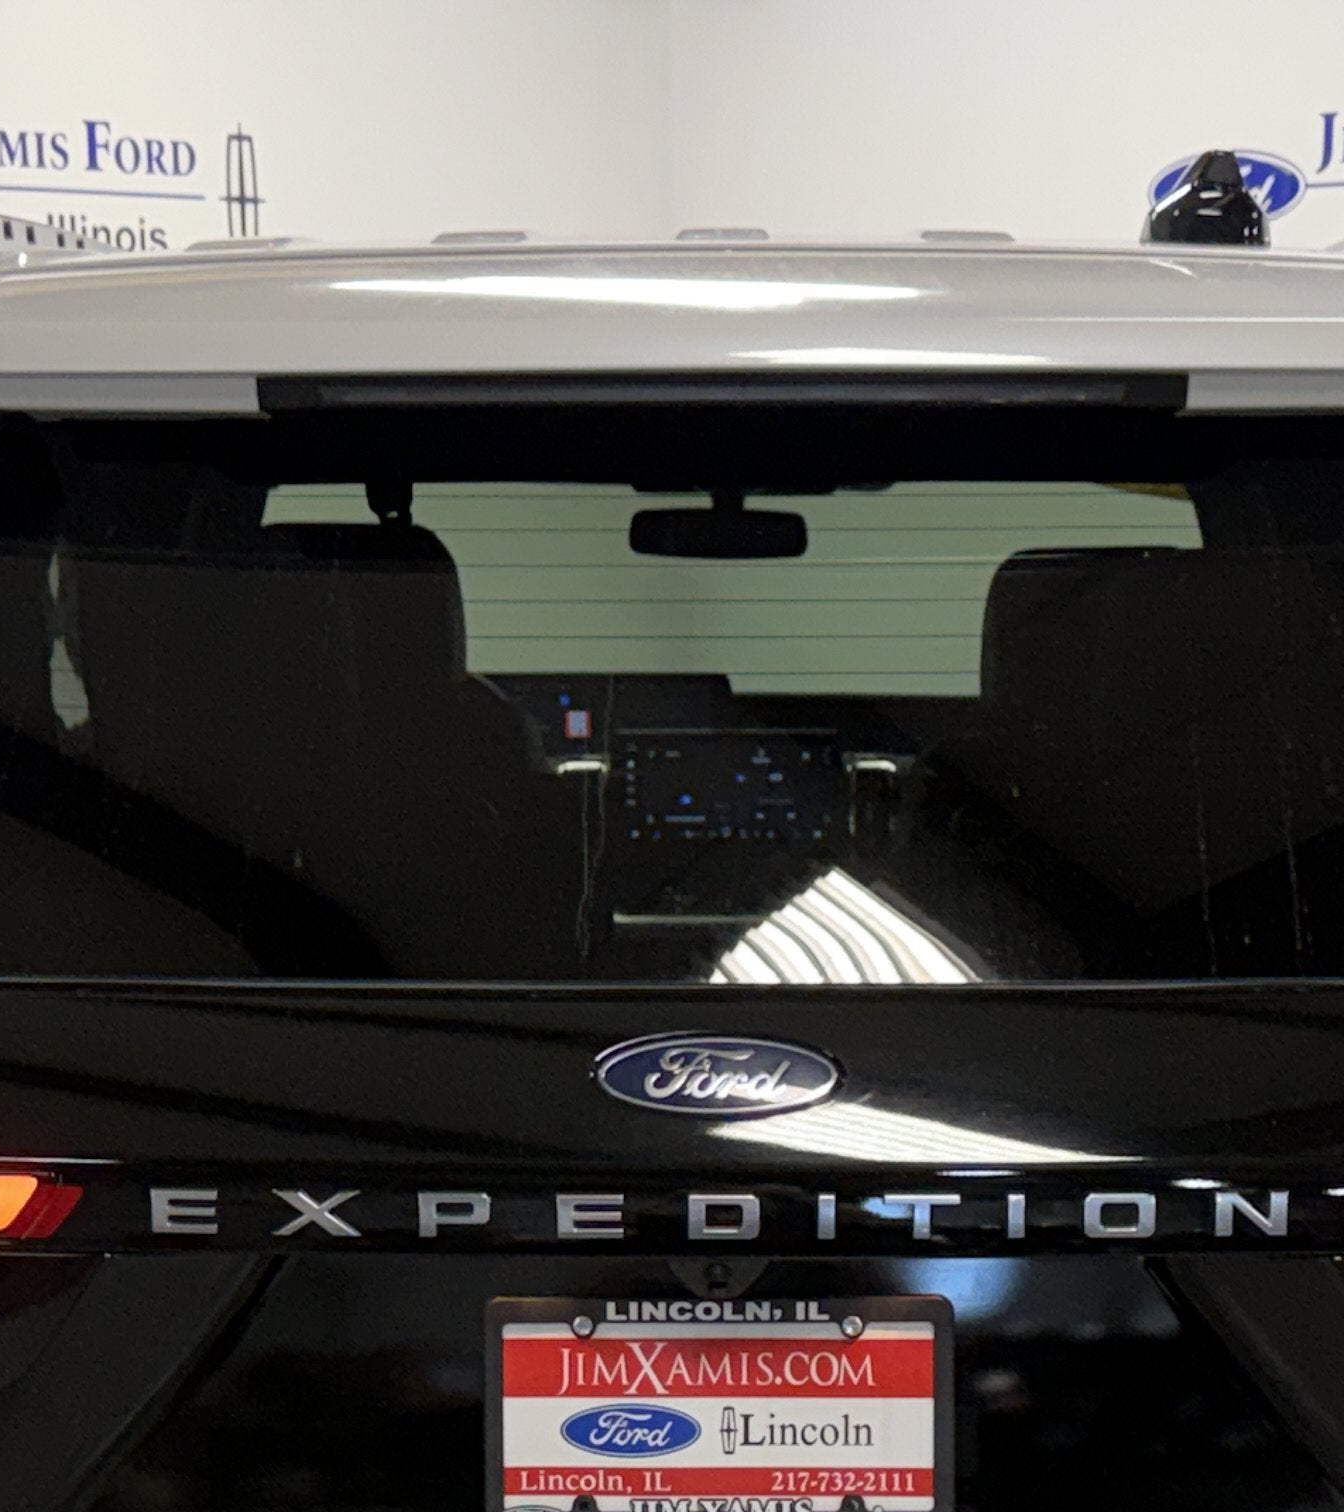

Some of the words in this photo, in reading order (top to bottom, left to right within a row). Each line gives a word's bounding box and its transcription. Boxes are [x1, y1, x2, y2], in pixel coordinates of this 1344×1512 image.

[83, 120, 196, 177] FORD
[644, 1047, 790, 1100] Ford
[150, 1186, 1291, 1242] EXPEDITION
[605, 1301, 783, 1322] LINCOLN,
[795, 1301, 830, 1321] IL
[558, 1341, 877, 1396] JIMXAMIS.COM
[589, 1410, 673, 1448] Ford
[739, 1413, 874, 1447] Lincoln
[520, 1470, 632, 1493] Lincoln,
[643, 1471, 673, 1491] IL
[771, 1471, 916, 1492] 217-732-2111
